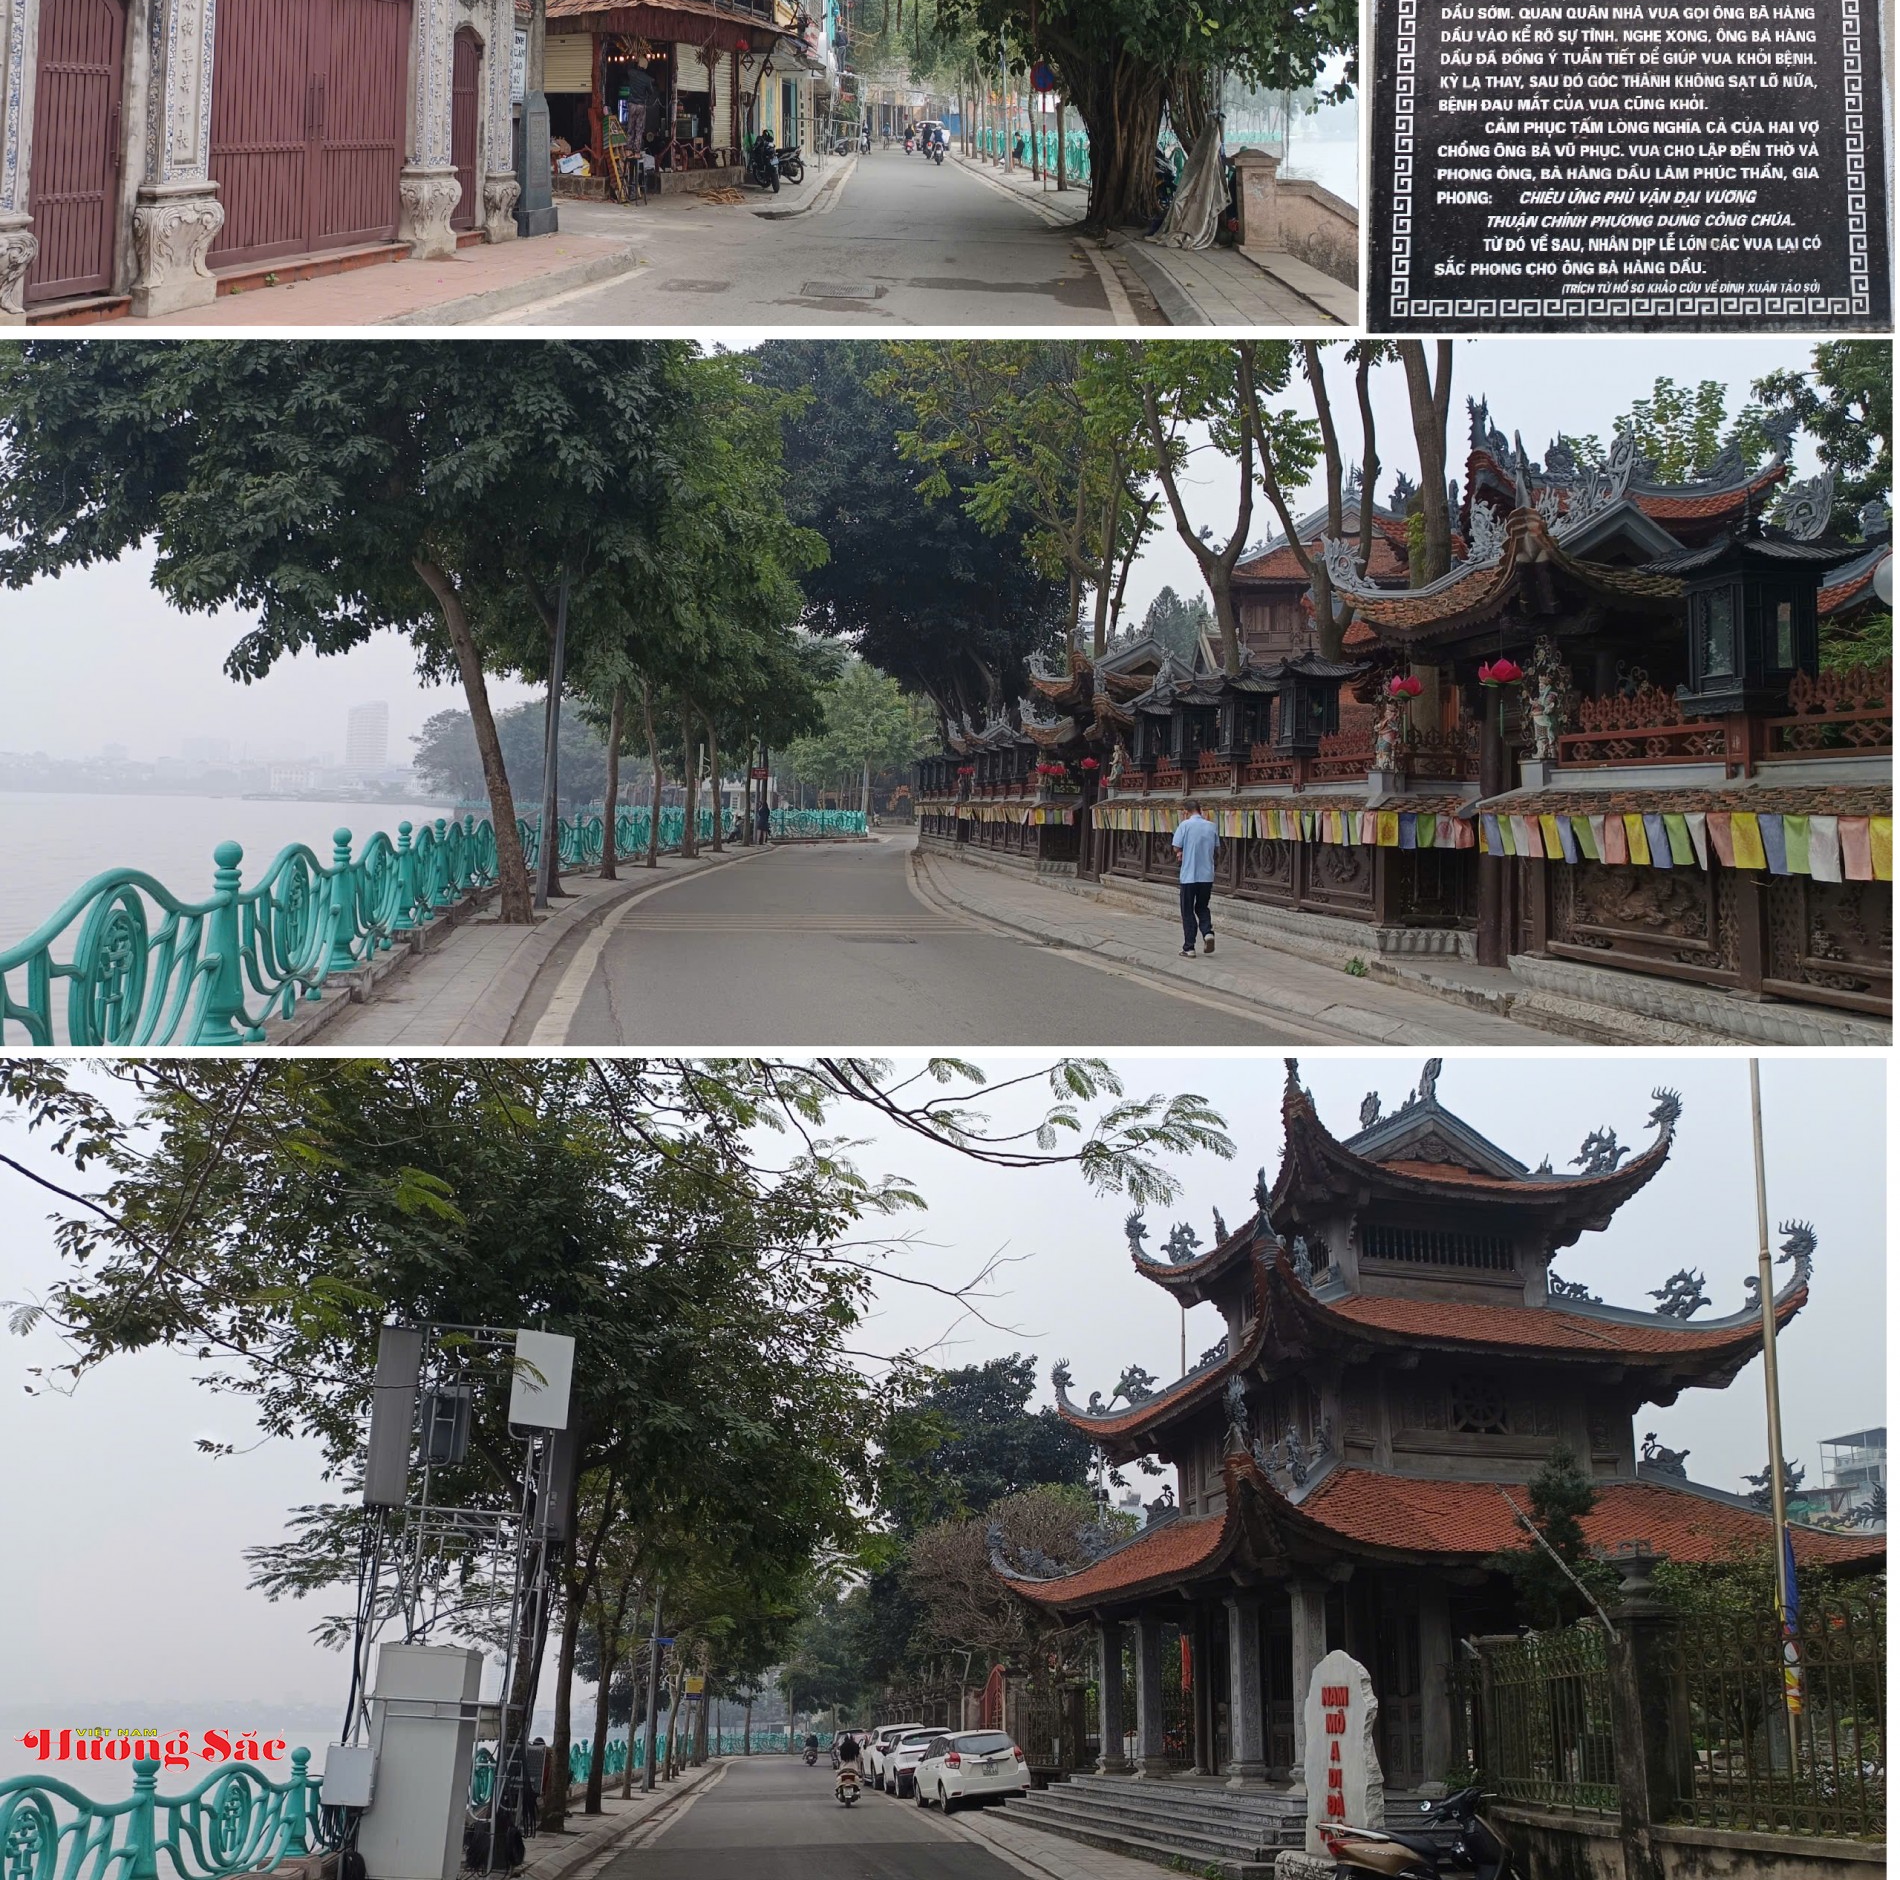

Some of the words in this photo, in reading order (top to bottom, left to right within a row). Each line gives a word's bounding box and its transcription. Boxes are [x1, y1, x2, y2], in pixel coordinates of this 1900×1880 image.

[1438, 97, 1478, 115] BỆNH
[1517, 94, 1551, 111] MẮT
[1552, 96, 1585, 111] CỦA
[1588, 99, 1620, 110] VUA
[1623, 96, 1665, 110] CŨNG
[1669, 96, 1709, 110] KHỎI.
[1484, 119, 1520, 134] CẢM
[1523, 122, 1567, 137] PHỤC
[1569, 117, 1604, 134] TẤM
[1607, 119, 1650, 134] LÒNG
[1652, 119, 1702, 134] NGHĨA
[1705, 119, 1728, 134] CẢ
[1730, 119, 1765, 134] CỦA
[1768, 122, 1794, 134] HAI
[1798, 122, 1820, 137] VỢ
[1436, 169, 1493, 181] PHONG
[1496, 166, 1537, 181] ÔNG,
[1540, 163, 1564, 180] BÀ
[1566, 165, 1612, 180] HÀNG
[1616, 163, 1651, 180] DẦU
[1655, 165, 1690, 180] LÀM
[1693, 165, 1737, 180] PHÚC
[1739, 163, 1788, 180] THẦN,
[1791, 167, 1820, 179] GIA
[1434, 255, 1466, 276] SẮC
[1470, 264, 1522, 276] PHONG
[1525, 263, 1558, 276] CHO
[1561, 260, 1595, 276] ÔNG
[1598, 257, 1619, 275] BÀ
[1623, 259, 1666, 274] HÀNG
[1669, 257, 1707, 274] DẦU.
[1321, 1686, 1349, 1707] NAM
[1325, 1708, 1346, 1734] MÔ
[1330, 1741, 1340, 1761] A
[1328, 1768, 1342, 1789] DI
[1327, 1791, 1346, 1818] ĐÀ
